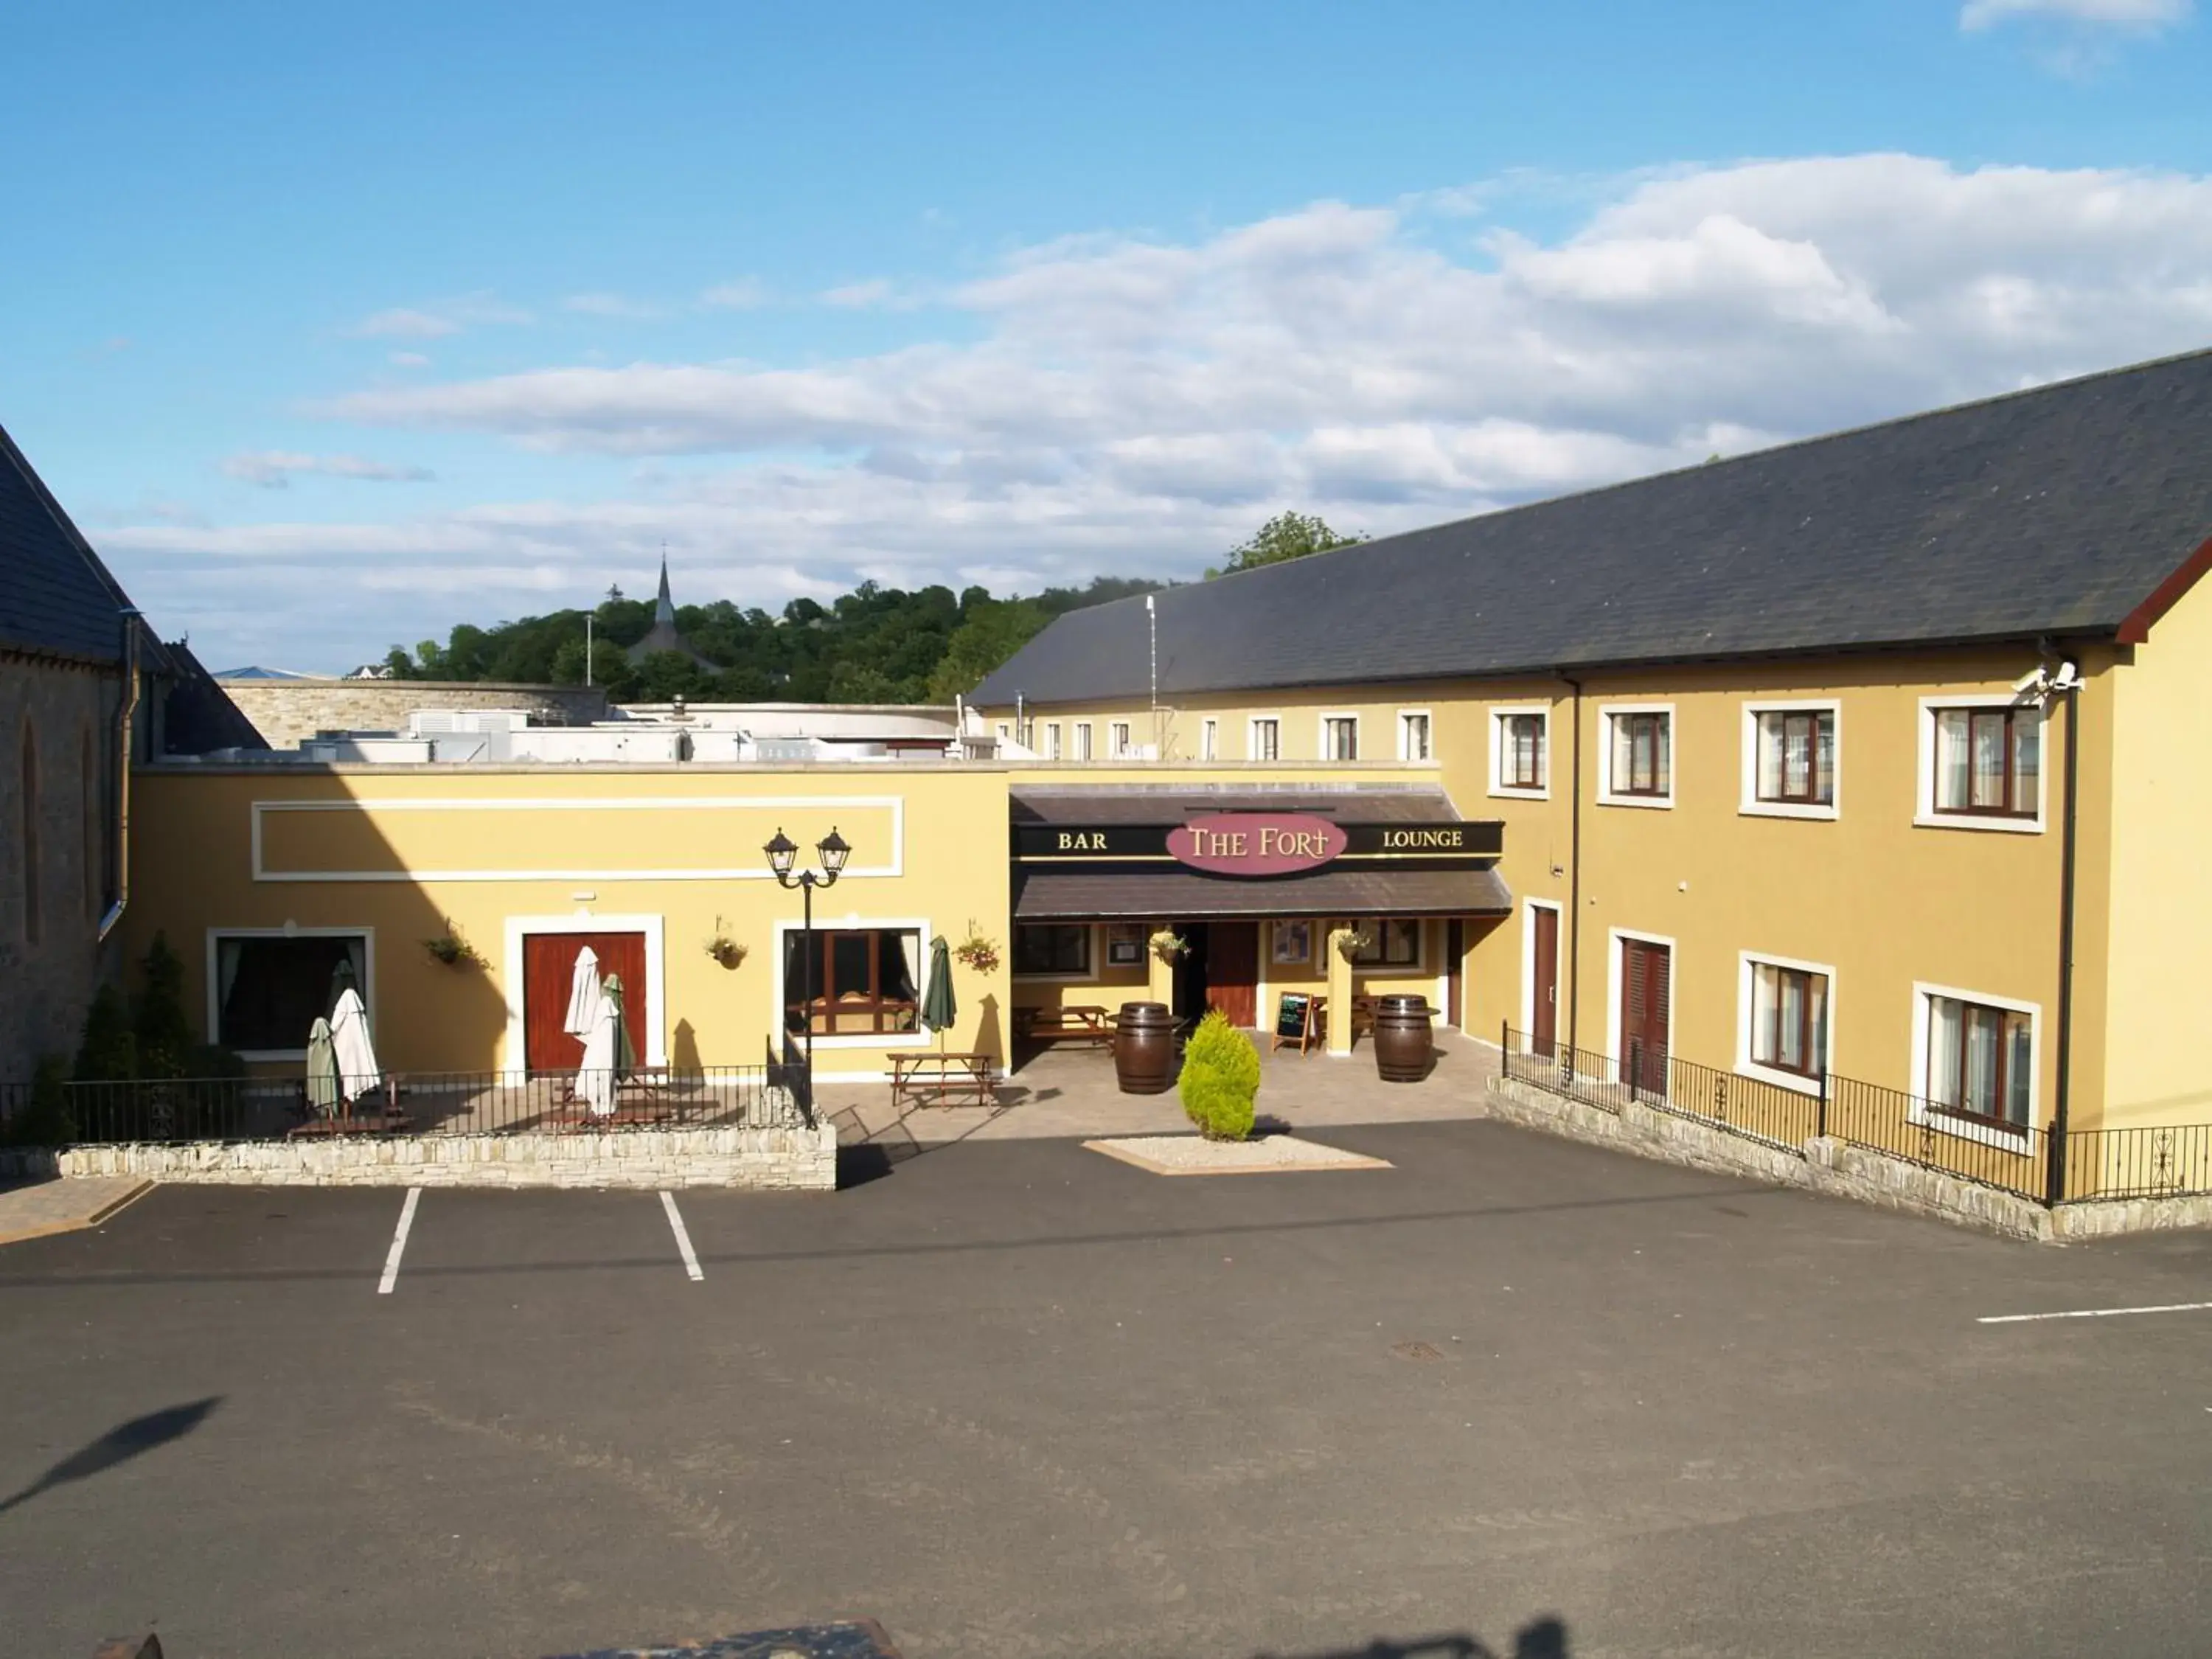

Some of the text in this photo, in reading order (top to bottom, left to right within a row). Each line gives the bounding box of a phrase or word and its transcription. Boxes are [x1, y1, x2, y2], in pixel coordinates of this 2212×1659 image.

[1059, 832, 1107, 849] BAR
[1188, 826, 1248, 856] THE
[1384, 831, 1463, 847] LOUNGE
